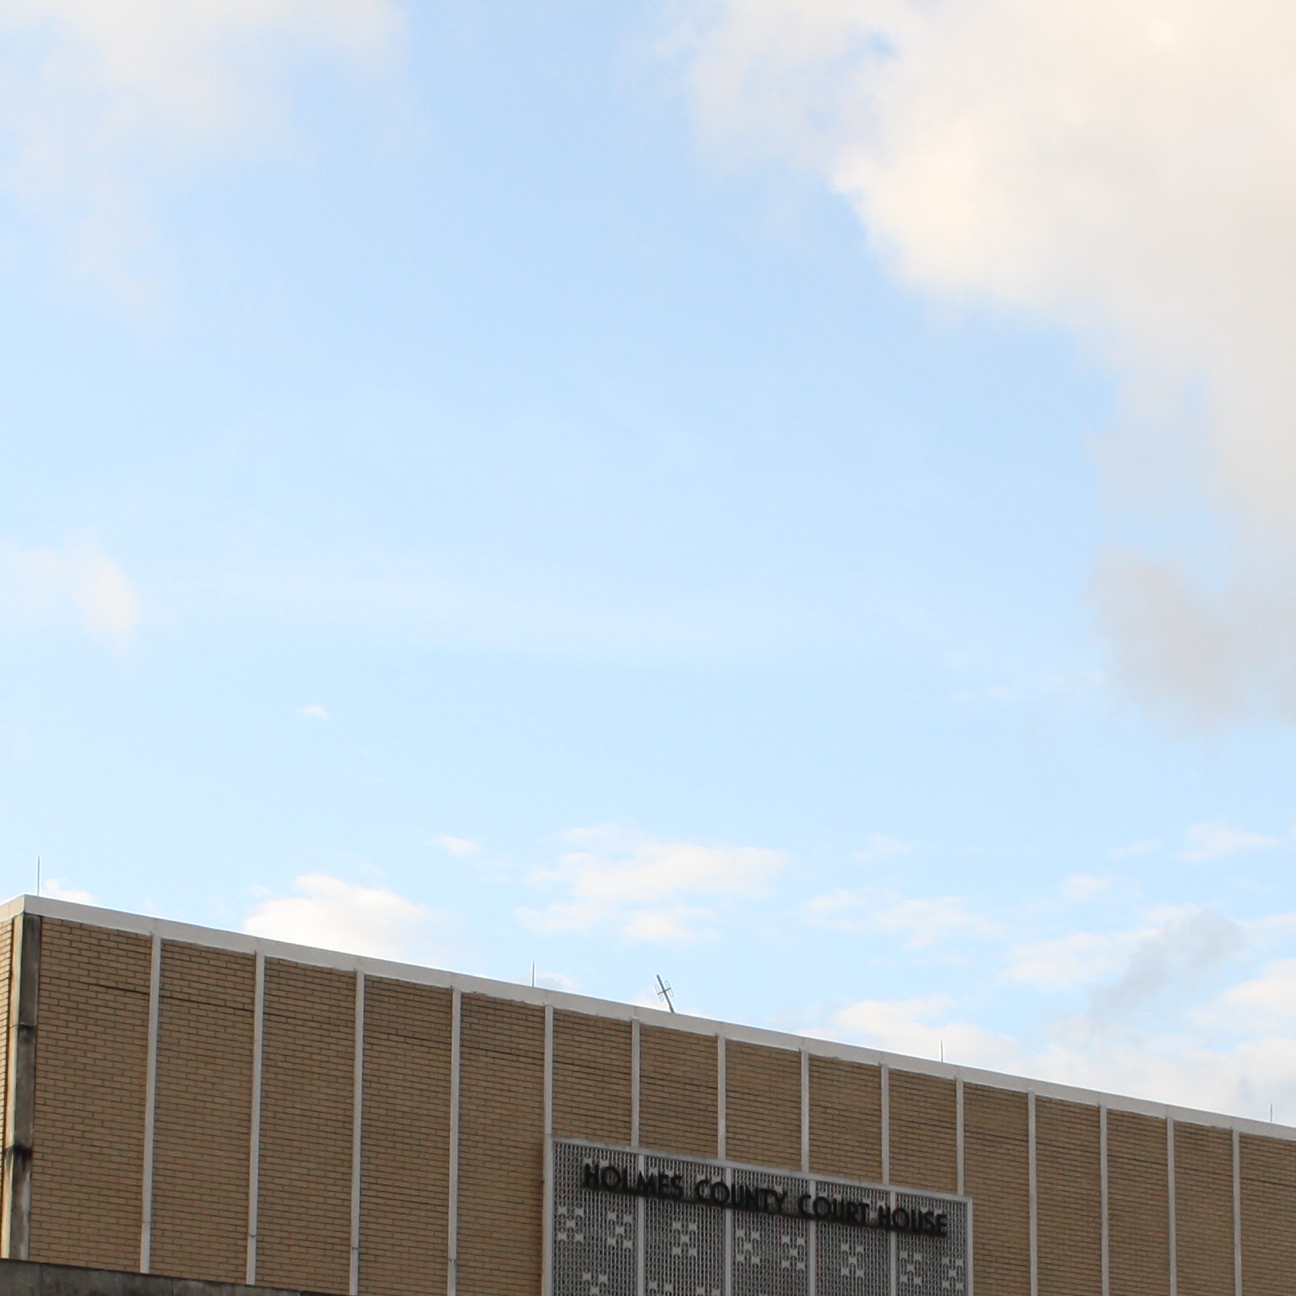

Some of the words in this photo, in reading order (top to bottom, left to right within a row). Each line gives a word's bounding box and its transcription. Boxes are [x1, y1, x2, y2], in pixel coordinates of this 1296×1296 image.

[583, 1163, 685, 1198] HOLMES
[694, 1179, 789, 1214] COUNTY
[797, 1194, 870, 1225] COURT
[877, 1203, 948, 1238] HOUSE
